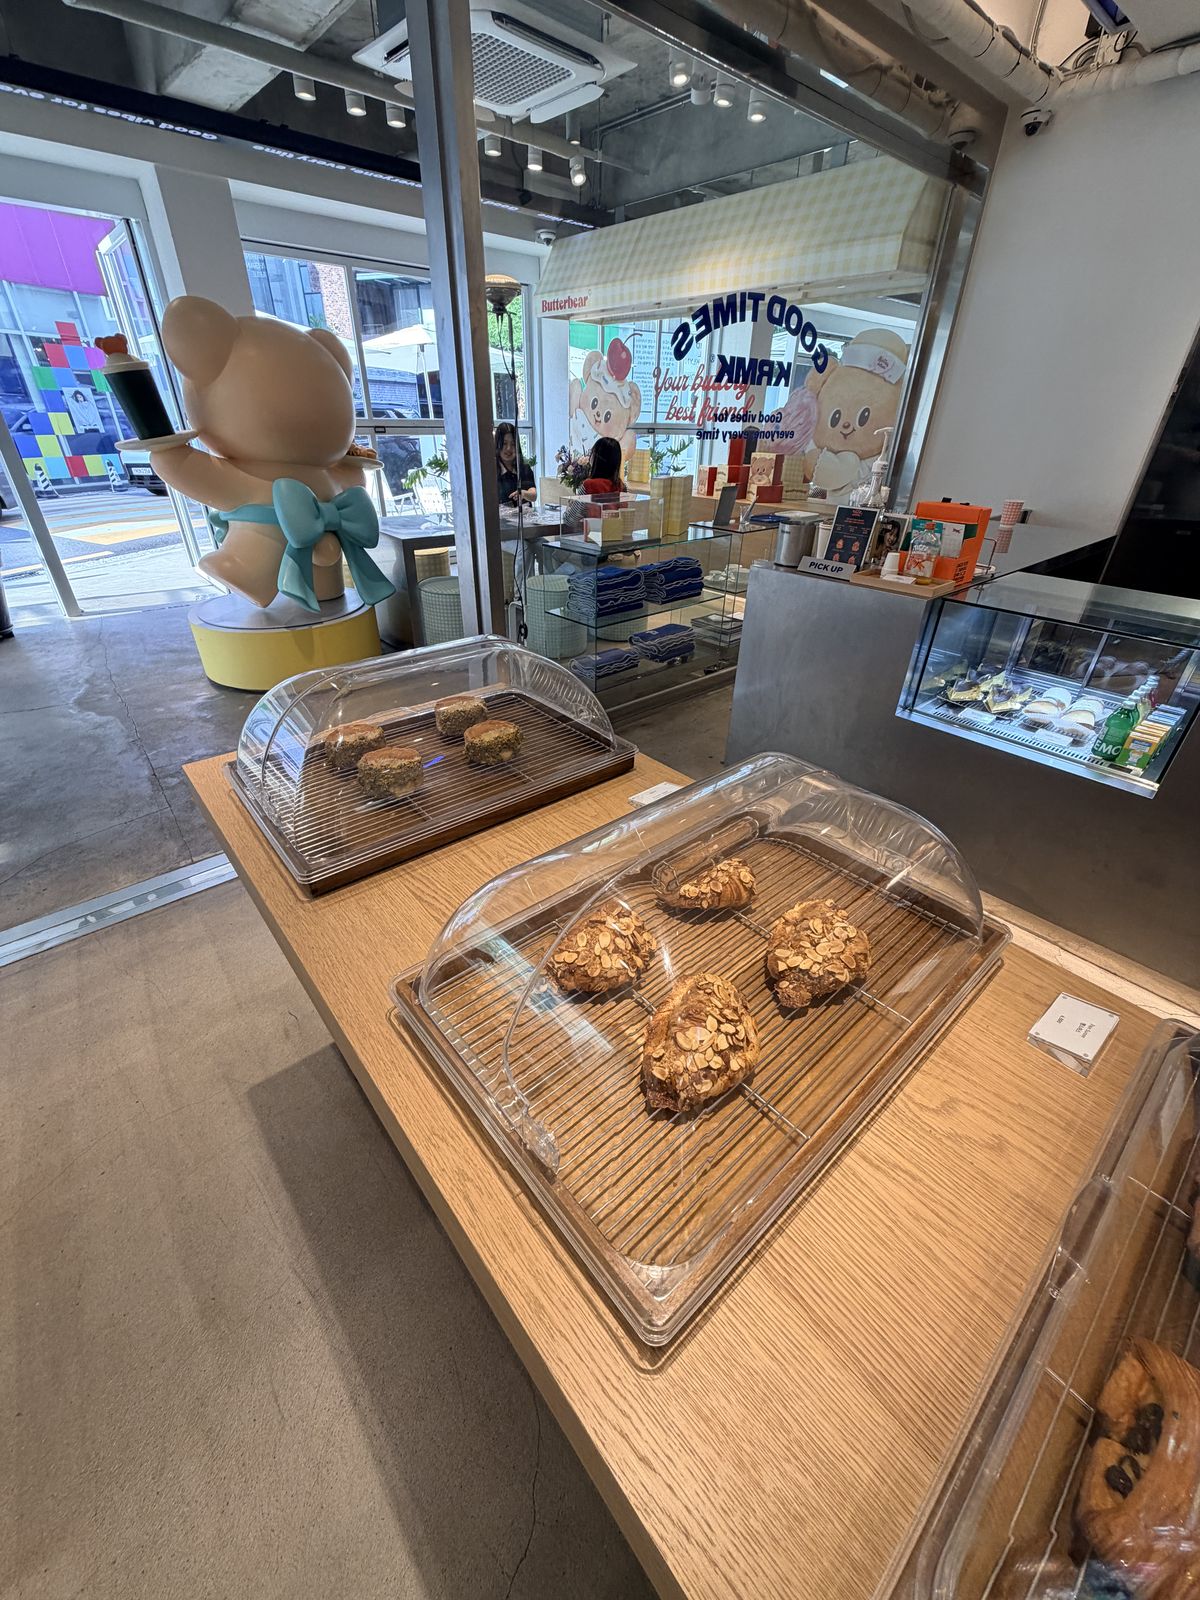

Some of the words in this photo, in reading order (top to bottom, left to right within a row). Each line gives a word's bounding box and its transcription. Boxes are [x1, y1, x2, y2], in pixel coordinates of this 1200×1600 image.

[541, 295, 589, 313] Butterbear
[653, 366, 690, 400] Your
[665, 395, 698, 421] best
[697, 394, 755, 427] friend
[808, 561, 830, 571] PICK
[830, 565, 844, 573] UP
